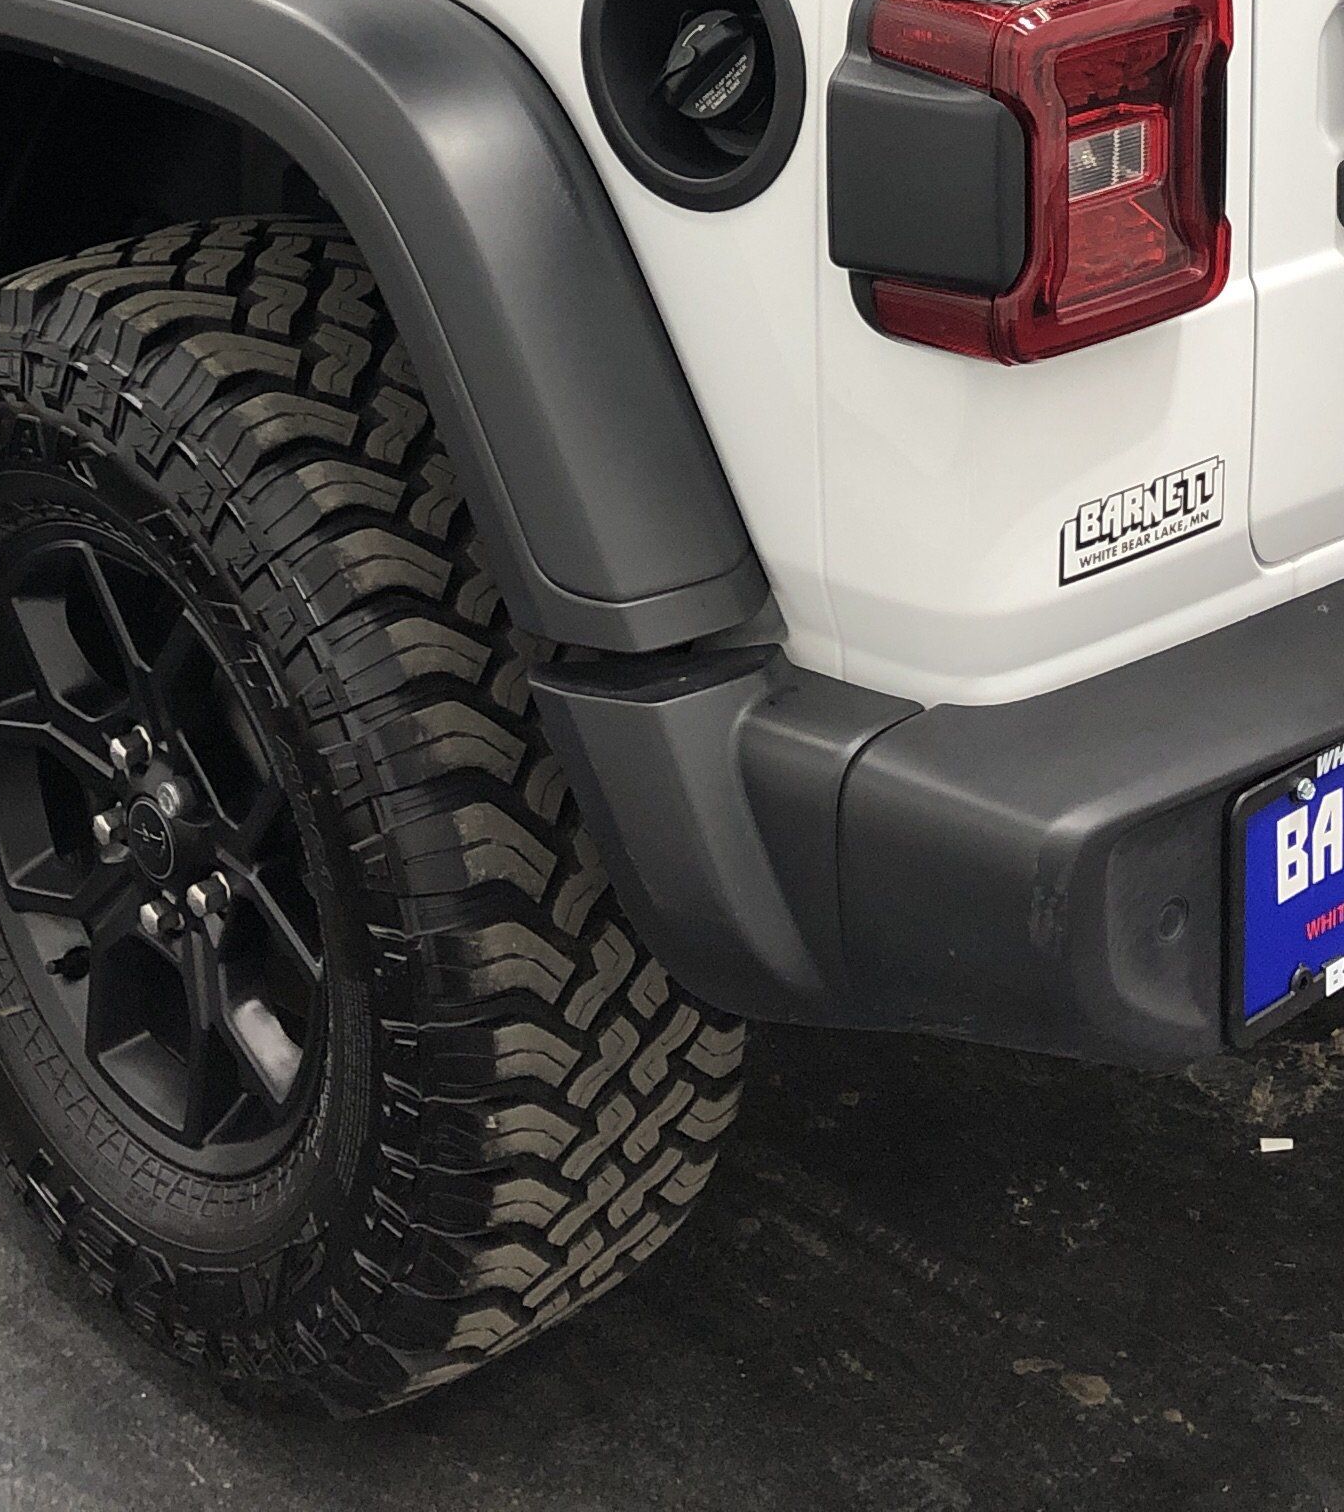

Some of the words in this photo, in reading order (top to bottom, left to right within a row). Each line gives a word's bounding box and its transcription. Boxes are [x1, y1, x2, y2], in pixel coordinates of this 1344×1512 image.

[1078, 454, 1219, 545] BARNETT
[1078, 545, 1118, 568] WHITE
[1121, 533, 1151, 554] BEAR
[1155, 519, 1189, 541] LAKE,
[1189, 509, 1210, 526] MN
